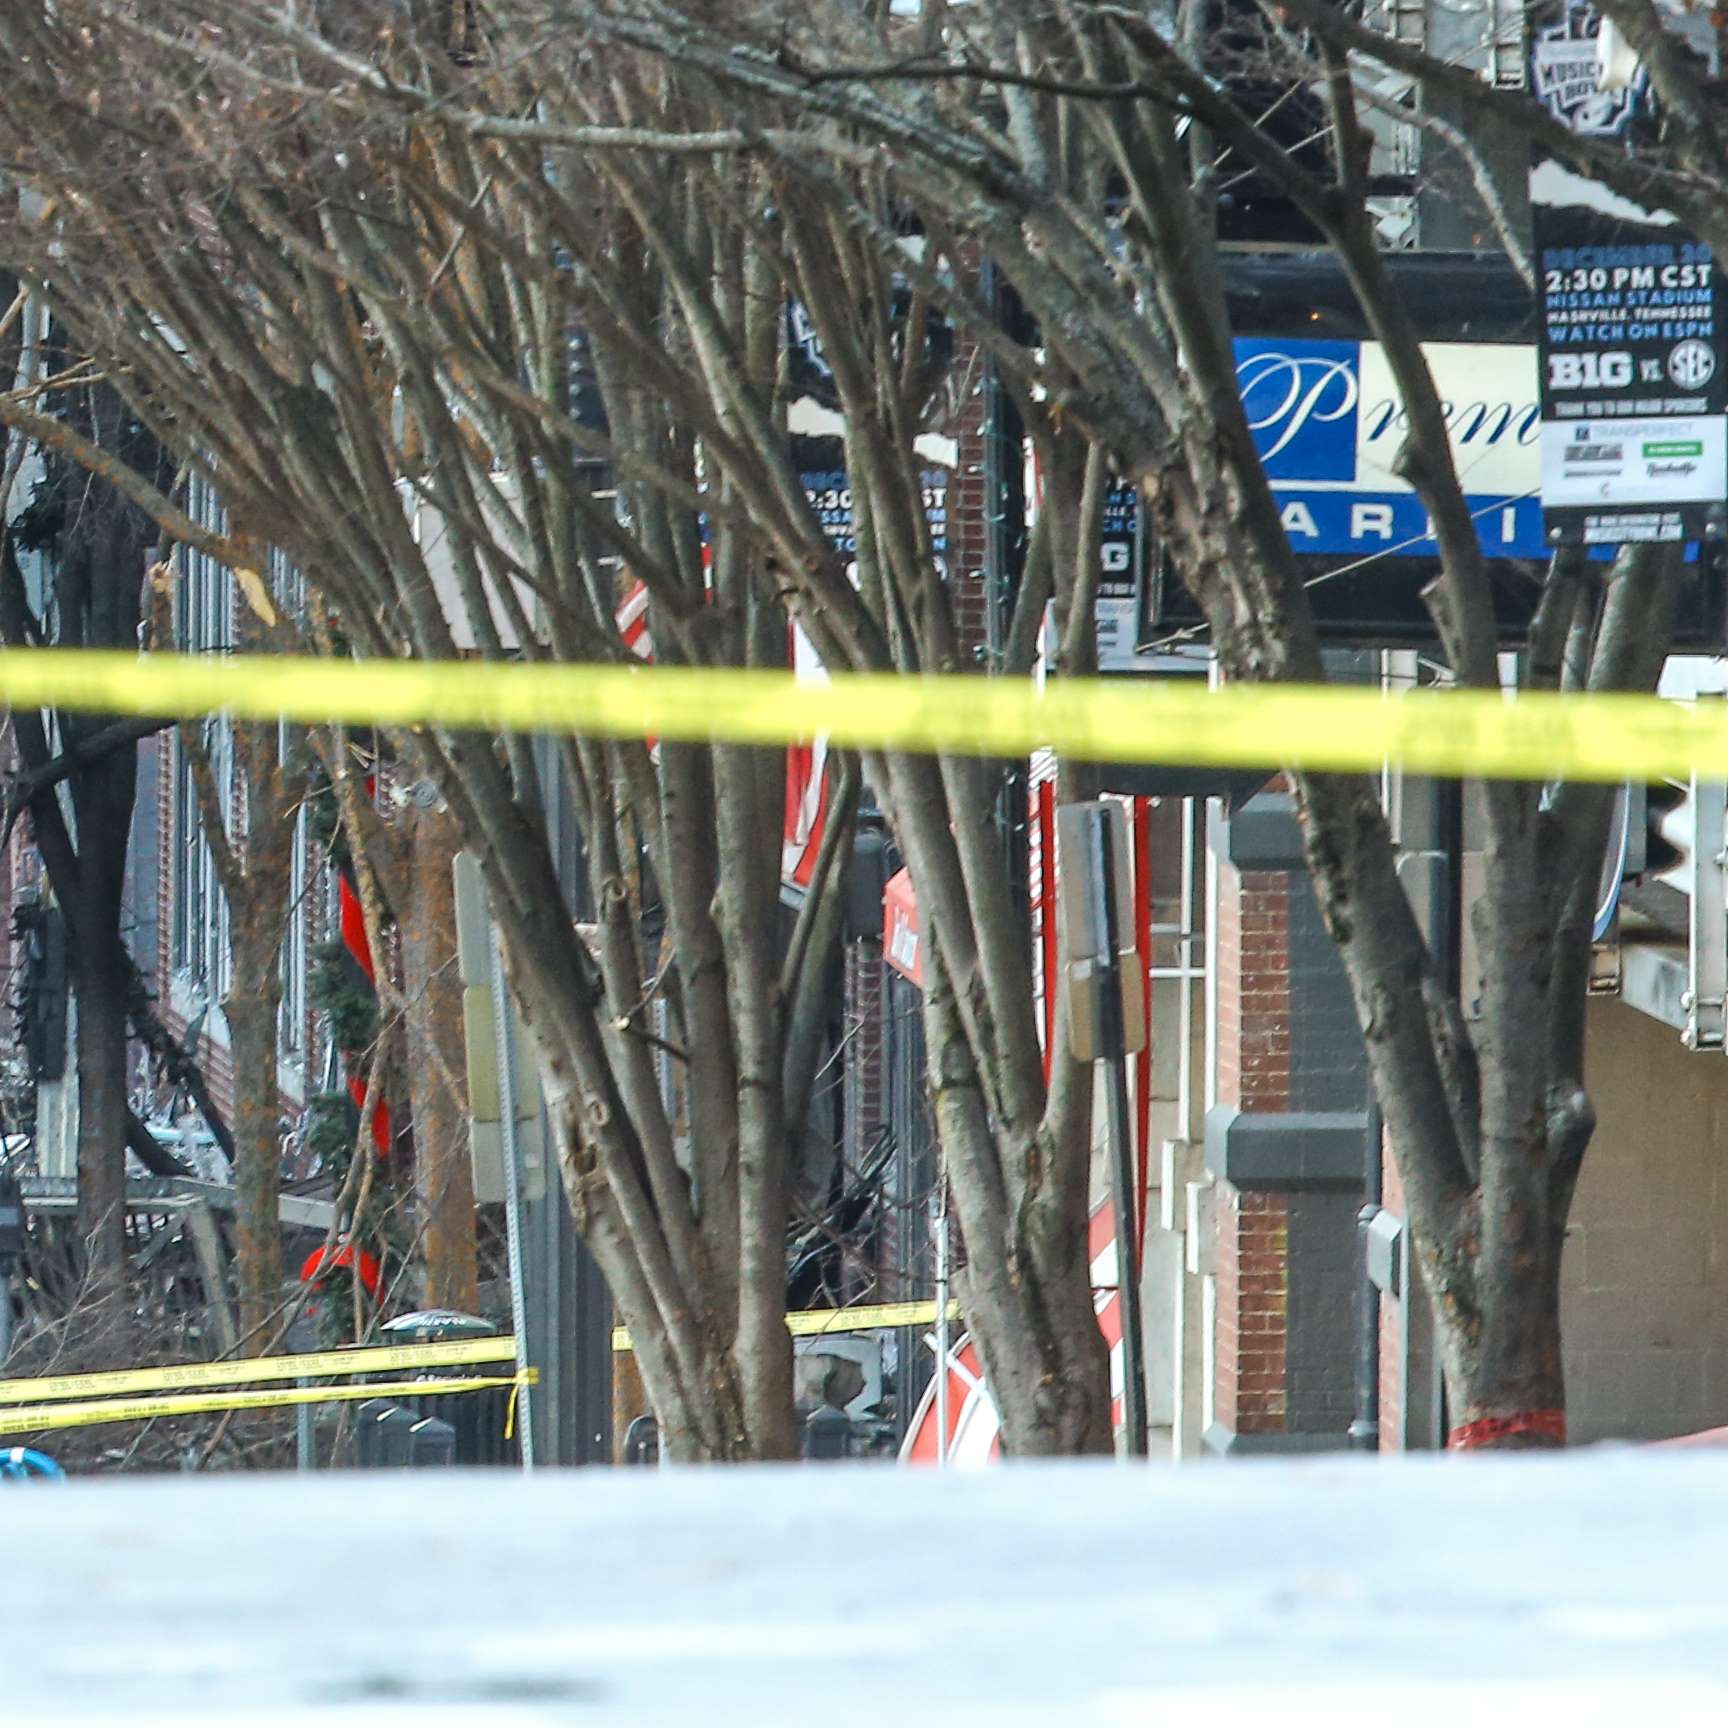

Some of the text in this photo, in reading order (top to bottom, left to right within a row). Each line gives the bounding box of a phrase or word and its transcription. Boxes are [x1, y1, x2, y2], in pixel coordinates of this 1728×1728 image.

[1545, 264, 1713, 293] 2:30 PM CST
[1546, 288, 1713, 308] NISSAN STADIUM
[1548, 322, 1713, 343] WATCH ON ESPN
